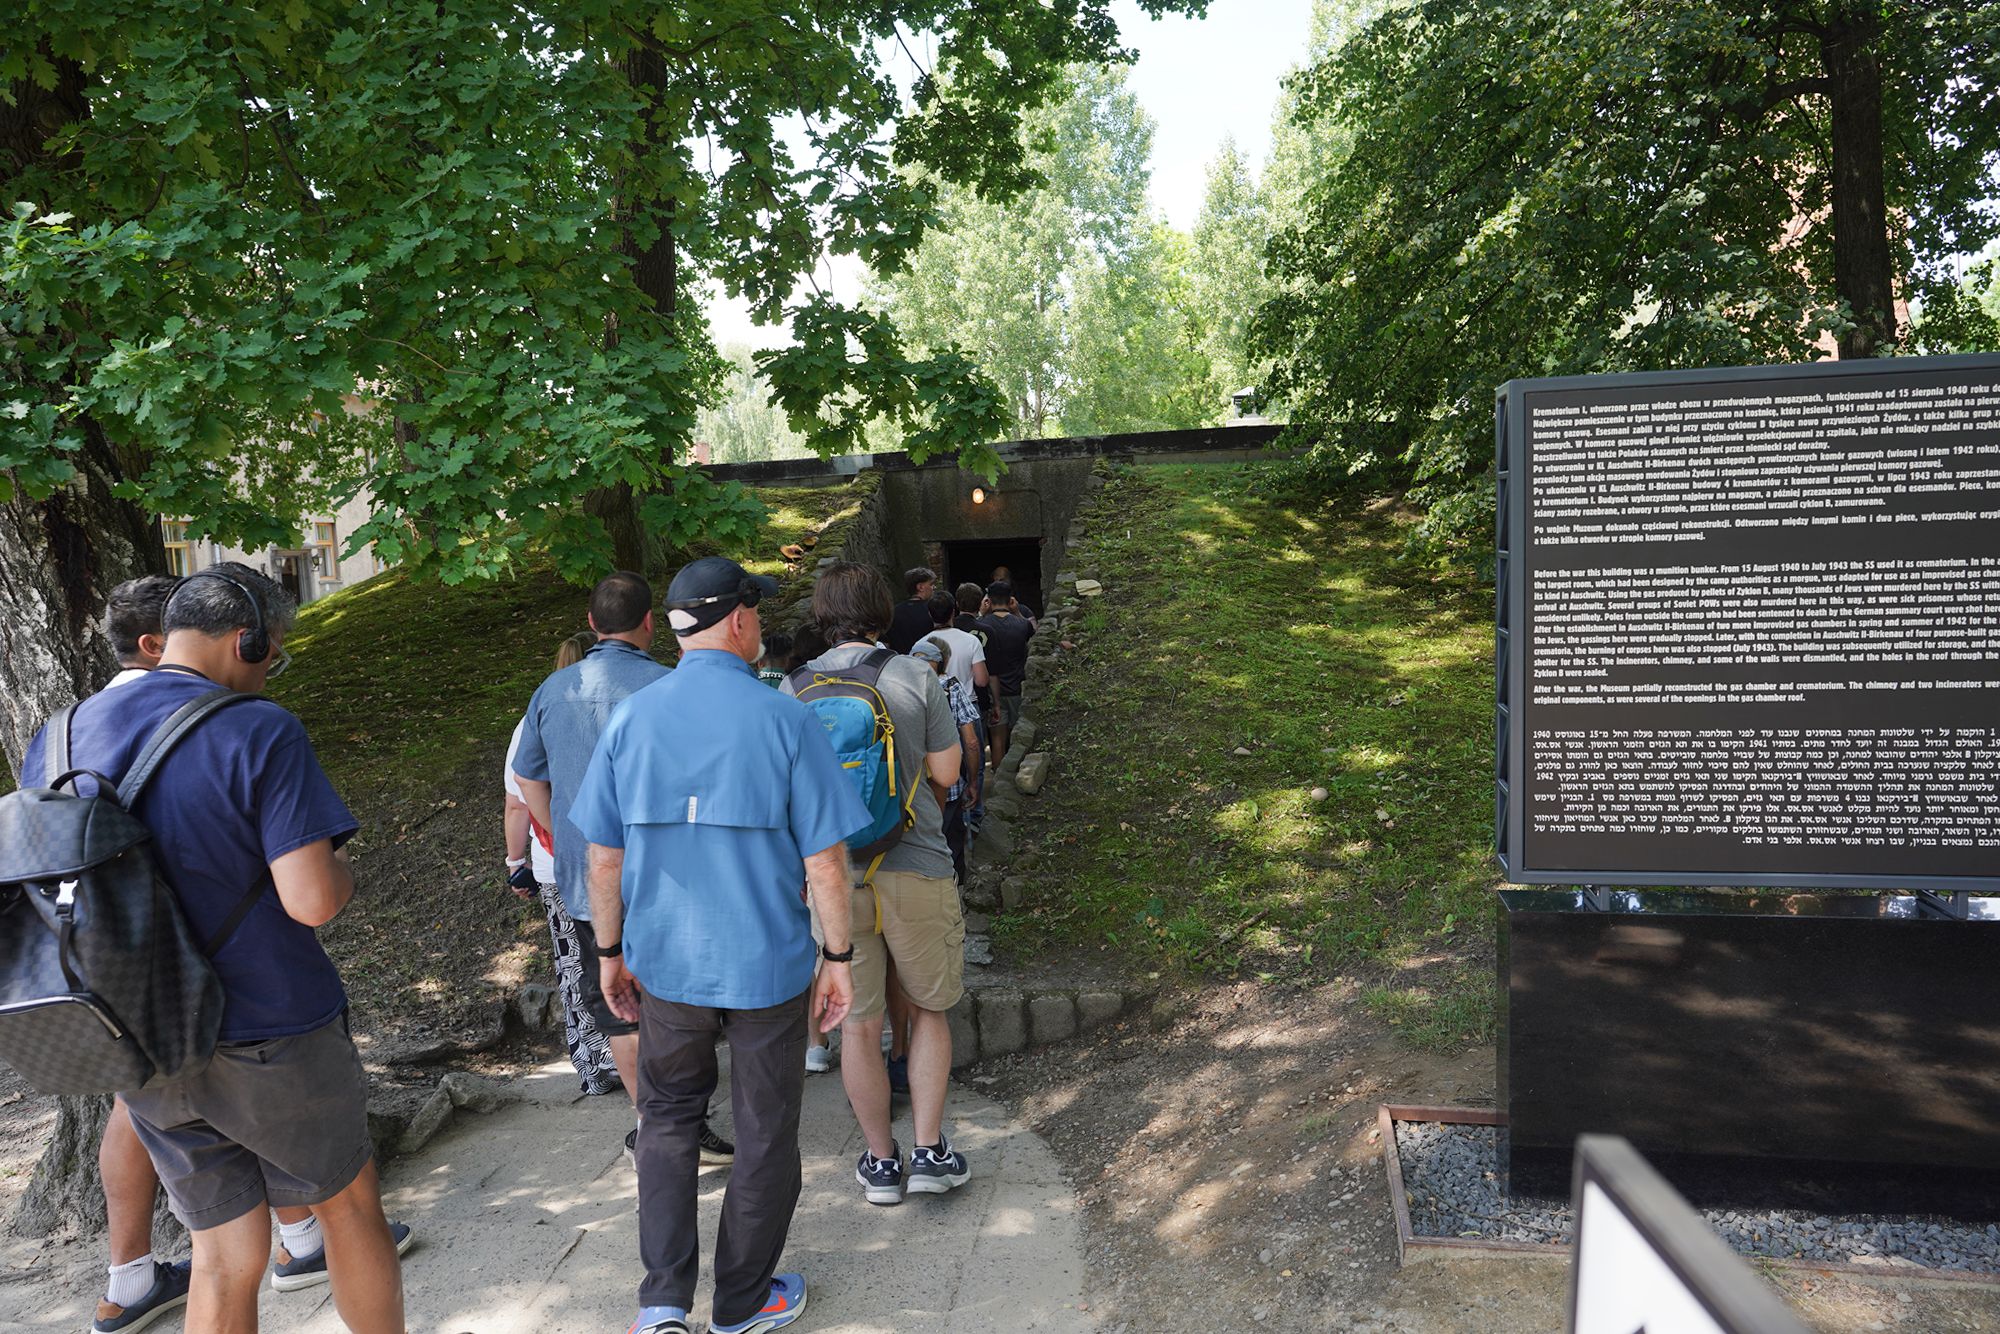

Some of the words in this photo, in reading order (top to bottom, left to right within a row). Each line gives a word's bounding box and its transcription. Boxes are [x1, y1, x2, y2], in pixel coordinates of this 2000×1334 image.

[1590, 403, 1628, 414] utworzone
[1630, 403, 1650, 412] przez
[1679, 399, 1702, 409] obozu
[1885, 389, 1896, 398] od
[1898, 388, 1909, 398] 15
[1912, 386, 1944, 398] sierpnia
[1947, 385, 1968, 395] 1940
[1970, 384, 1990, 394] roku
[1587, 450, 1596, 459] tu
[1650, 446, 1688, 457] skazanych
[1688, 447, 1699, 455] na
[1724, 445, 1744, 454] przez
[1745, 442, 1782, 452] niemiecki
[1620, 507, 1626, 515] a
[1627, 505, 1653, 515] otwory
[1653, 506, 1660, 514] w
[1690, 504, 1710, 513] przez
[1731, 501, 1767, 511] esesmani
[1768, 500, 1799, 510] wrzucali
[1799, 499, 1824, 509] cyklon
[1560, 535, 1579, 545] kilka
[1611, 535, 1618, 543] w
[1618, 533, 1644, 543] stropie
[1645, 532, 1673, 543] komory
[1674, 531, 1706, 542] gazowej.
[1534, 569, 1558, 579] Before
[1558, 569, 1571, 578] the
[1586, 568, 1602, 577] this
[1602, 567, 1632, 577] building
[1633, 568, 1648, 576] was
[1655, 565, 1690, 575] munition
[1690, 564, 1720, 574] bunker.
[1720, 564, 1740, 573] From
[1741, 564, 1752, 573] 15
[1752, 563, 1779, 573] August
[1780, 562, 1800, 572] 1940
[1801, 562, 1810, 571] to
[1811, 562, 1827, 571] July
[1828, 561, 1848, 570] 1943
[1850, 561, 1864, 570] the
[1864, 560, 1875, 569] SS
[1876, 560, 1896, 569] used
[1896, 559, 1904, 568] it
[1905, 560, 1914, 568] as
[1970, 557, 1980, 566] In
[1981, 557, 1996, 566] the
[1534, 669, 1558, 678] Zyklon
[1558, 668, 1564, 677] B
[1583, 668, 1609, 677] sealed.
[1533, 684, 1552, 694] After
[1553, 684, 1566, 693] the
[1585, 684, 1598, 693] the
[1600, 684, 1630, 693] Museum
[1632, 683, 1663, 693] partially
[1714, 682, 1728, 691] the
[1730, 684, 1743, 692] gas
[1745, 682, 1778, 691] chamber
[1779, 682, 1794, 691] and
[1848, 681, 1864, 690] The
[1865, 680, 1898, 690] chimney
[1900, 680, 1916, 689] and
[1918, 680, 1933, 689] two
[1534, 695, 1561, 705] original
[1606, 696, 1616, 704] as
[1616, 696, 1634, 704] were
[1634, 694, 1661, 703] several
[1661, 695, 1670, 703] of
[1670, 694, 1684, 703] the
[1684, 694, 1717, 703] openings
[1718, 694, 1726, 702] in
[1727, 694, 1740, 702] the
[1741, 695, 1754, 703] gas
[1755, 693, 1787, 702] chamber
[1788, 693, 1806, 702] roof.
